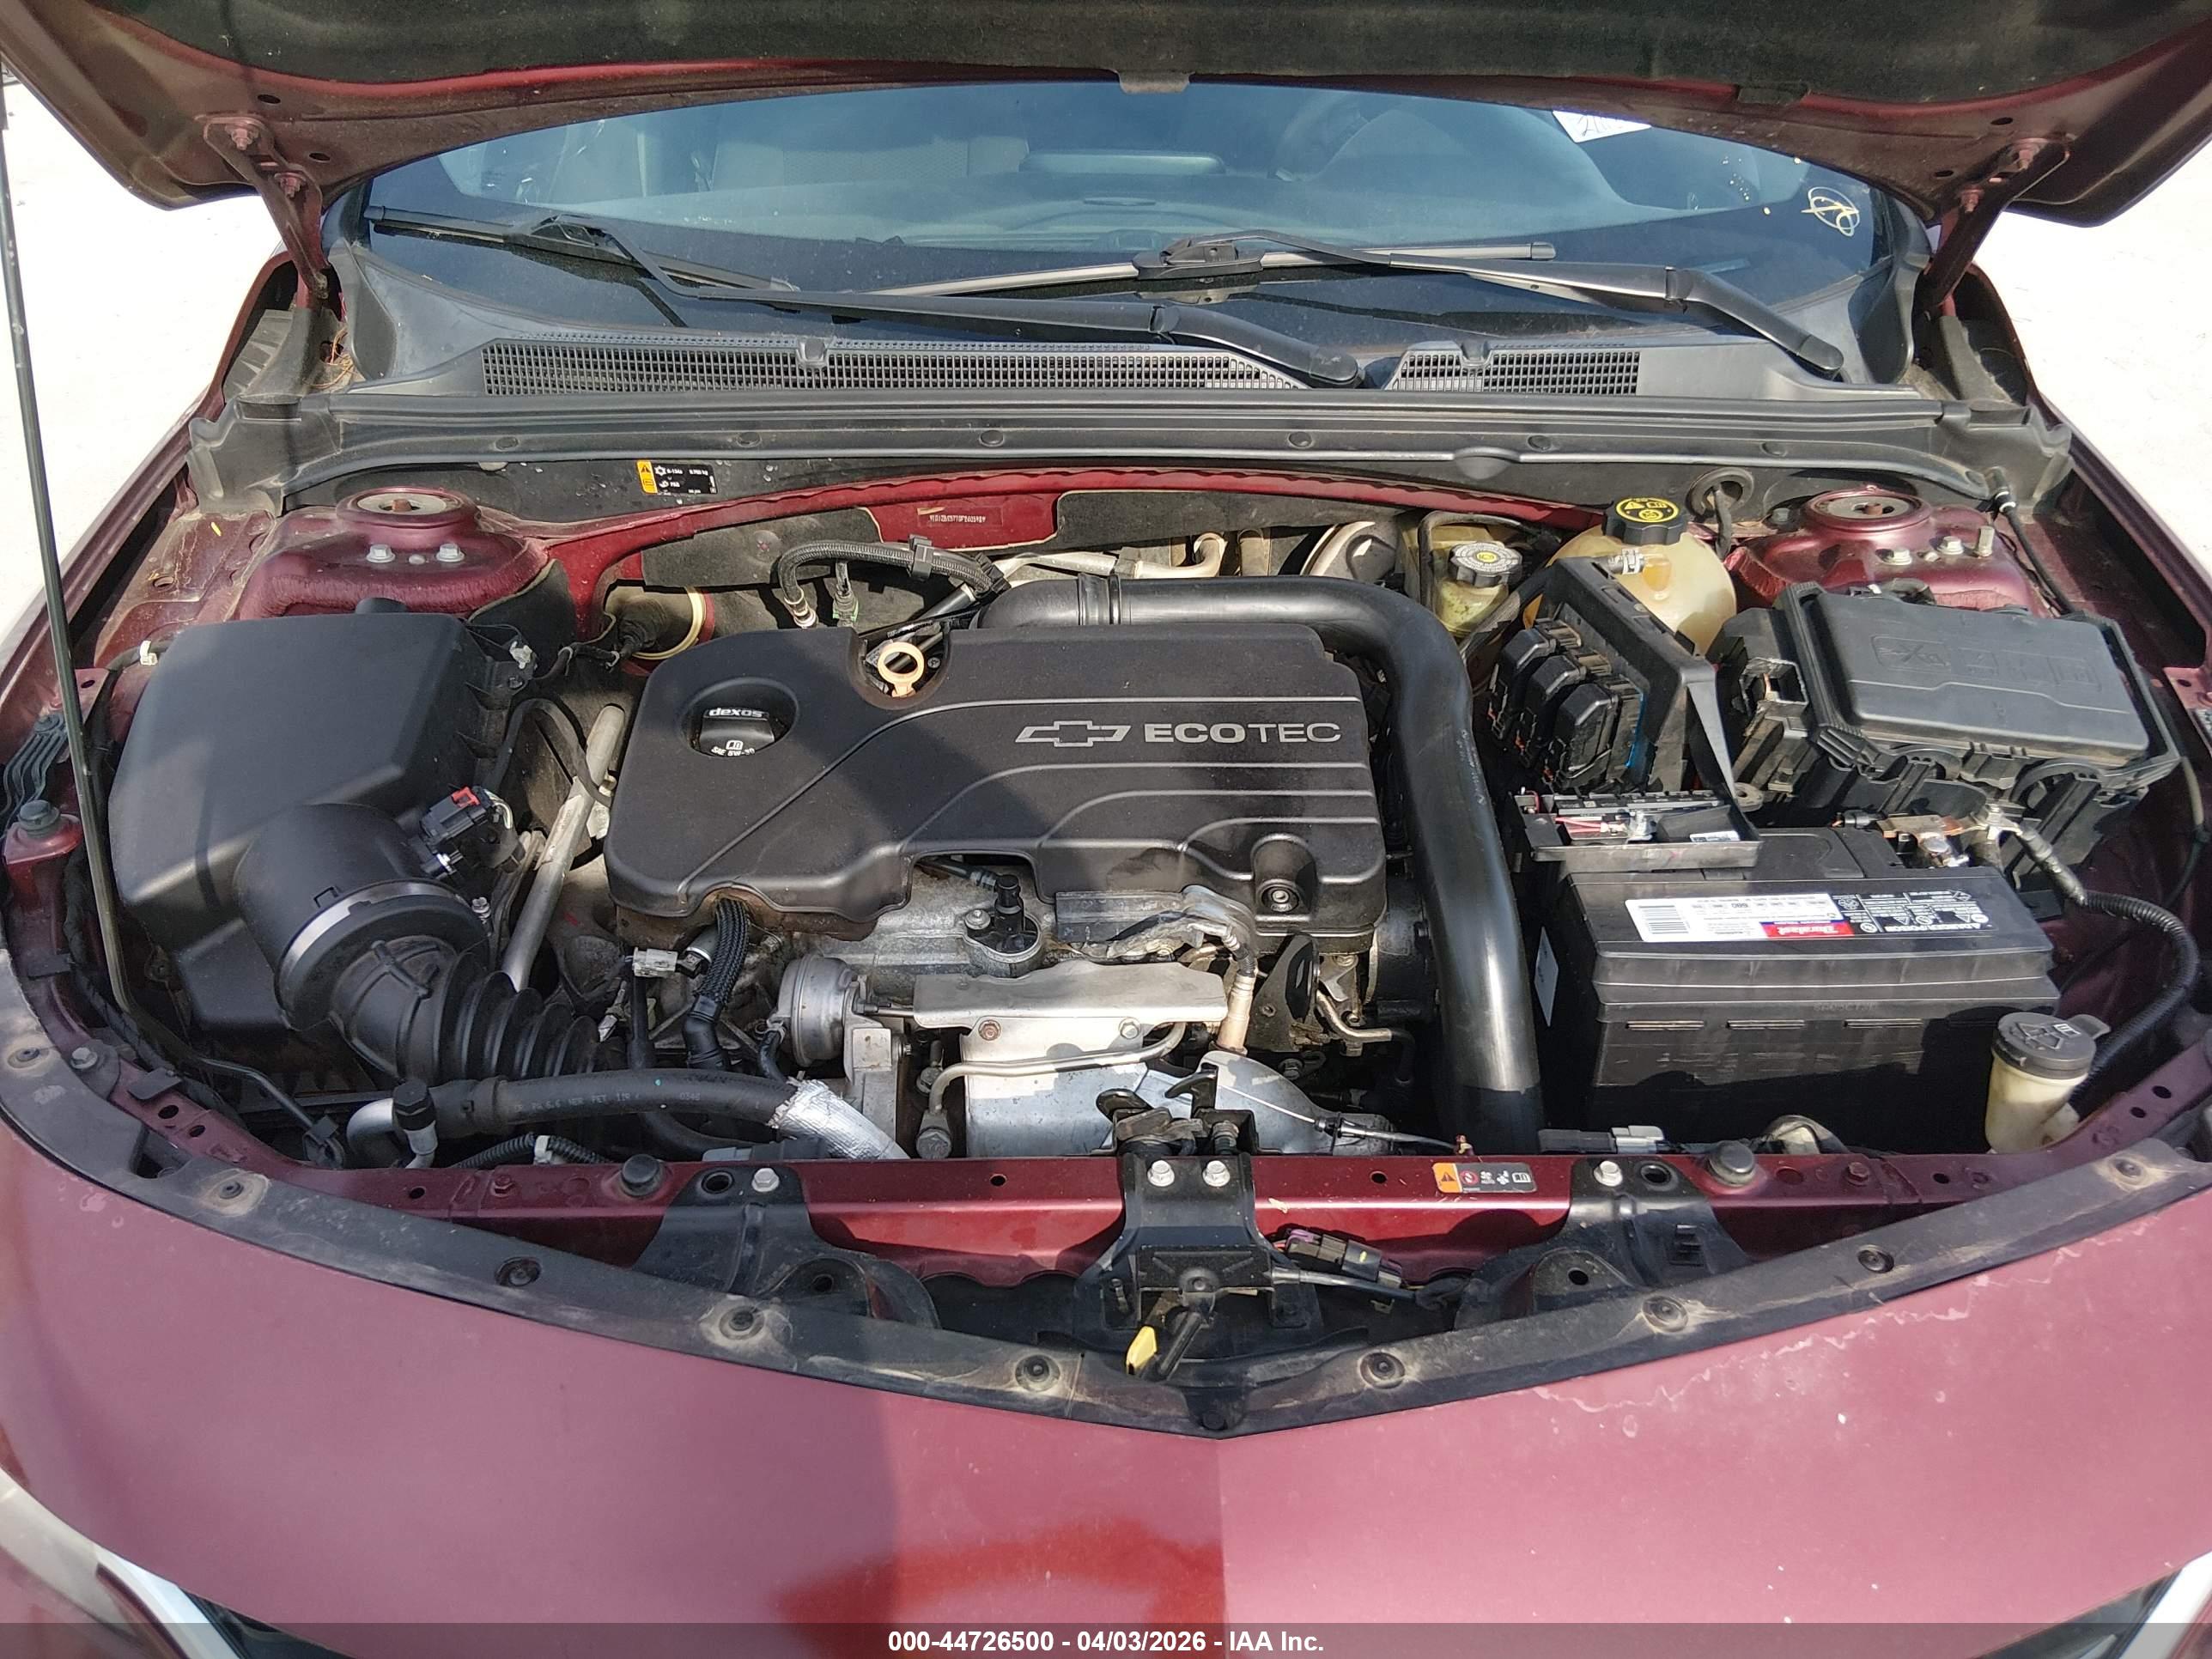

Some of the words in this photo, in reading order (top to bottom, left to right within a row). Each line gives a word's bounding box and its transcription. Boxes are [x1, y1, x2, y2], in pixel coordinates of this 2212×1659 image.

[708, 708, 763, 718] dexos
[1144, 722, 1341, 744] ECOTEC
[711, 746, 726, 756] SAE
